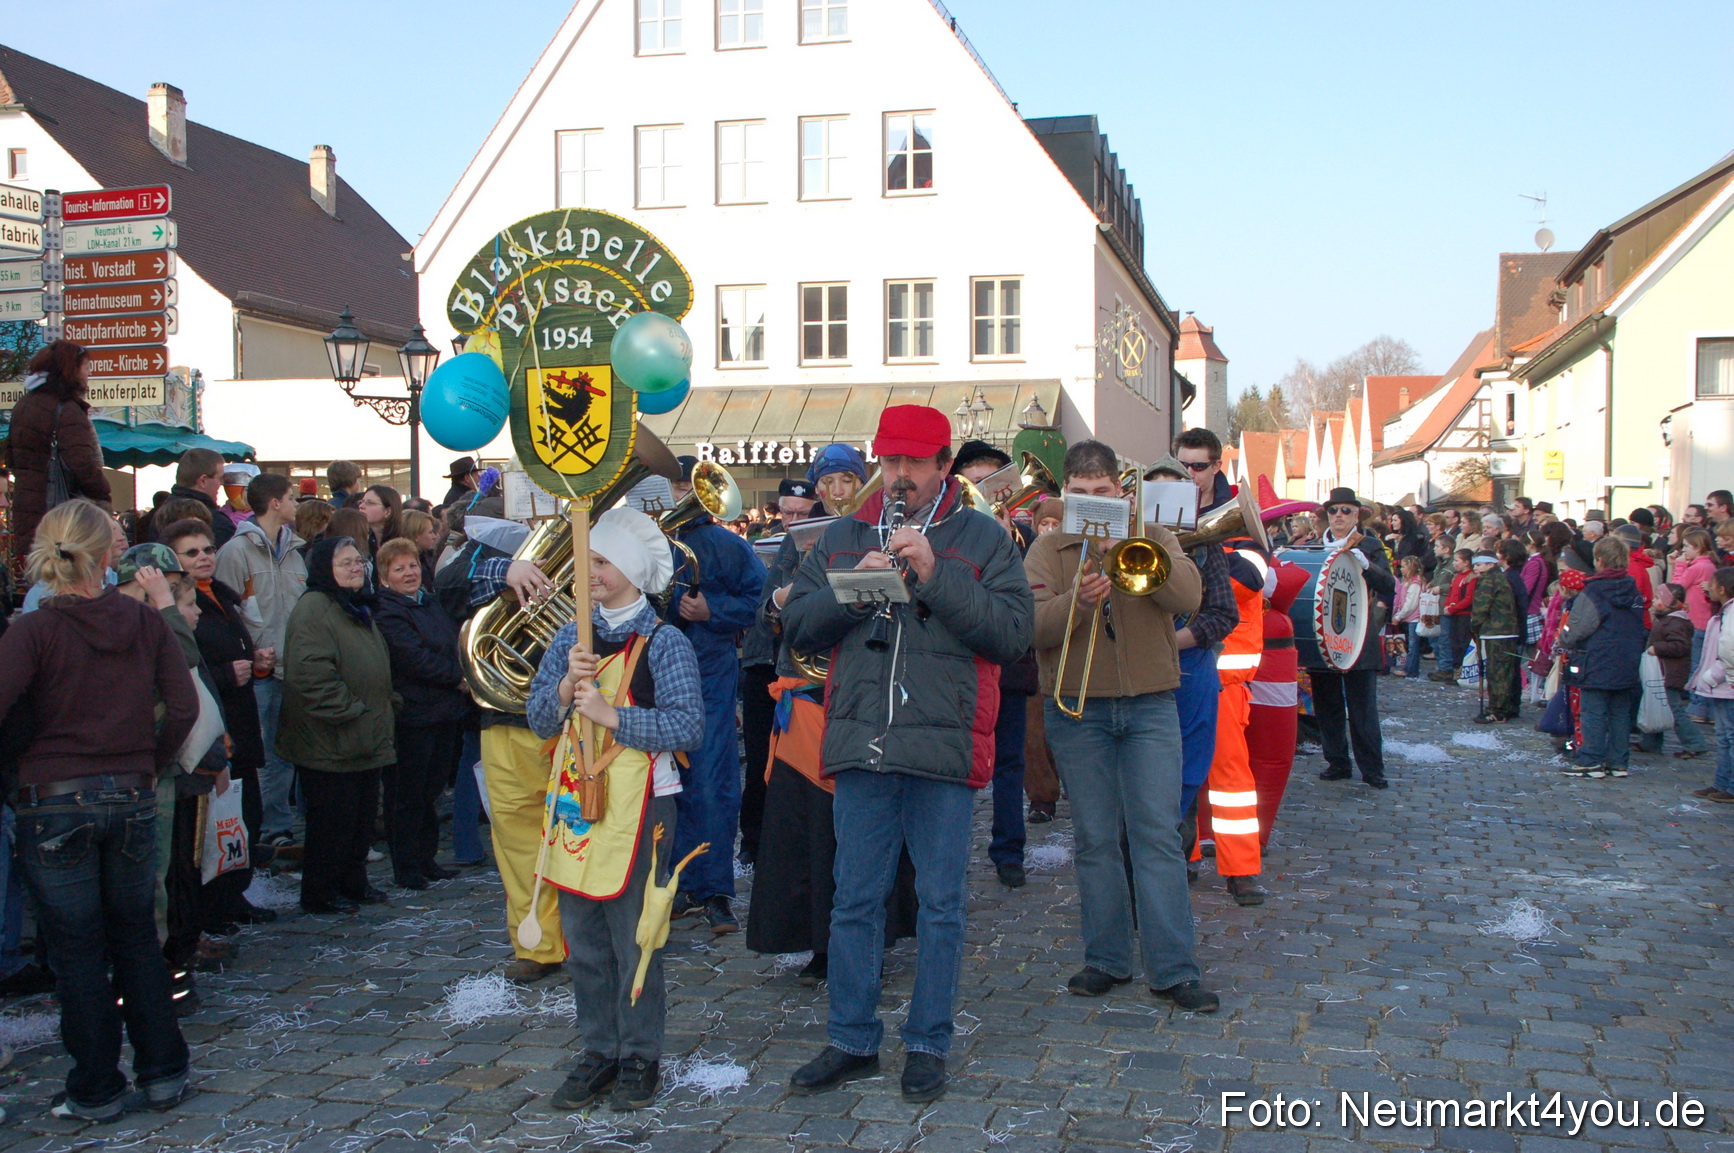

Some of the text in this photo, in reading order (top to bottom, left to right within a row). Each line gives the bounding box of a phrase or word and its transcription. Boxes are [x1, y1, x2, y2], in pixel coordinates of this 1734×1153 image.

[0, 191, 39, 212] ahalle
[64, 196, 134, 214] Tourist-Information
[1, 224, 40, 246] fabrik
[94, 225, 125, 237] Neumarkt
[87, 237, 121, 250] LDM-Kanal
[131, 237, 142, 247] km
[10, 270, 21, 281] km
[65, 259, 136, 280] hist. Vorstadt
[452, 225, 673, 324] Blaskapelle
[11, 301, 22, 311] km
[65, 293, 142, 312] Heimatmuseum
[65, 320, 147, 344] Stadtpfarrkirche
[542, 326, 594, 351] 1954
[1323, 567, 1356, 625] BLASKAPELLE
